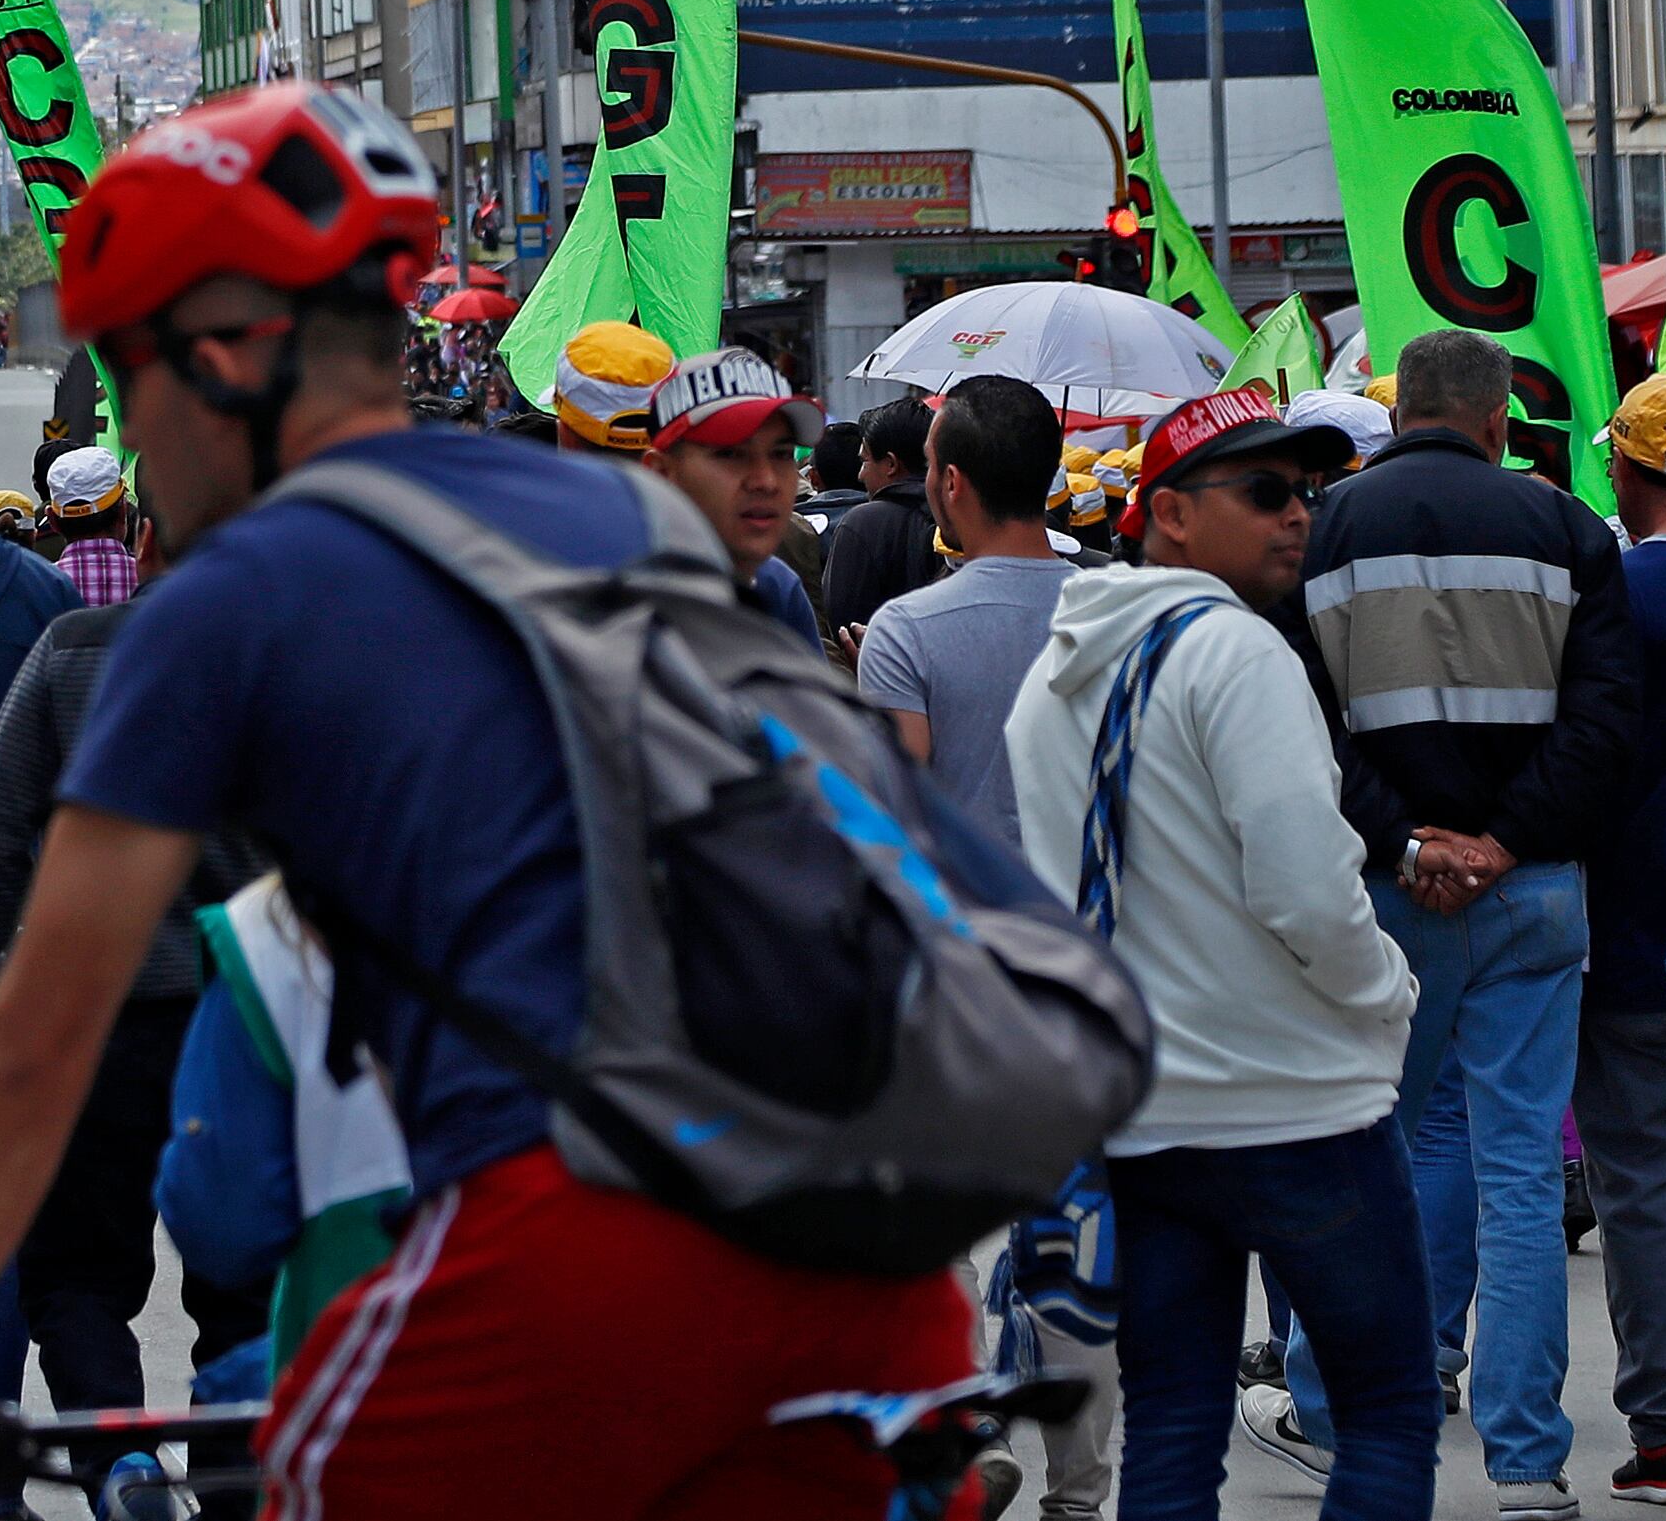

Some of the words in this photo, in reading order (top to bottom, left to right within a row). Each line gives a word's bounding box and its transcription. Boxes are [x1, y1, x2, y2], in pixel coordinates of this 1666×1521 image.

[1392, 88, 1521, 118] COLOMBIA
[836, 184, 941, 200] ESCOLAR
[695, 366, 722, 404] EL
[1205, 394, 1253, 431] VIVA
[1170, 419, 1219, 457] VIOLENCIA
